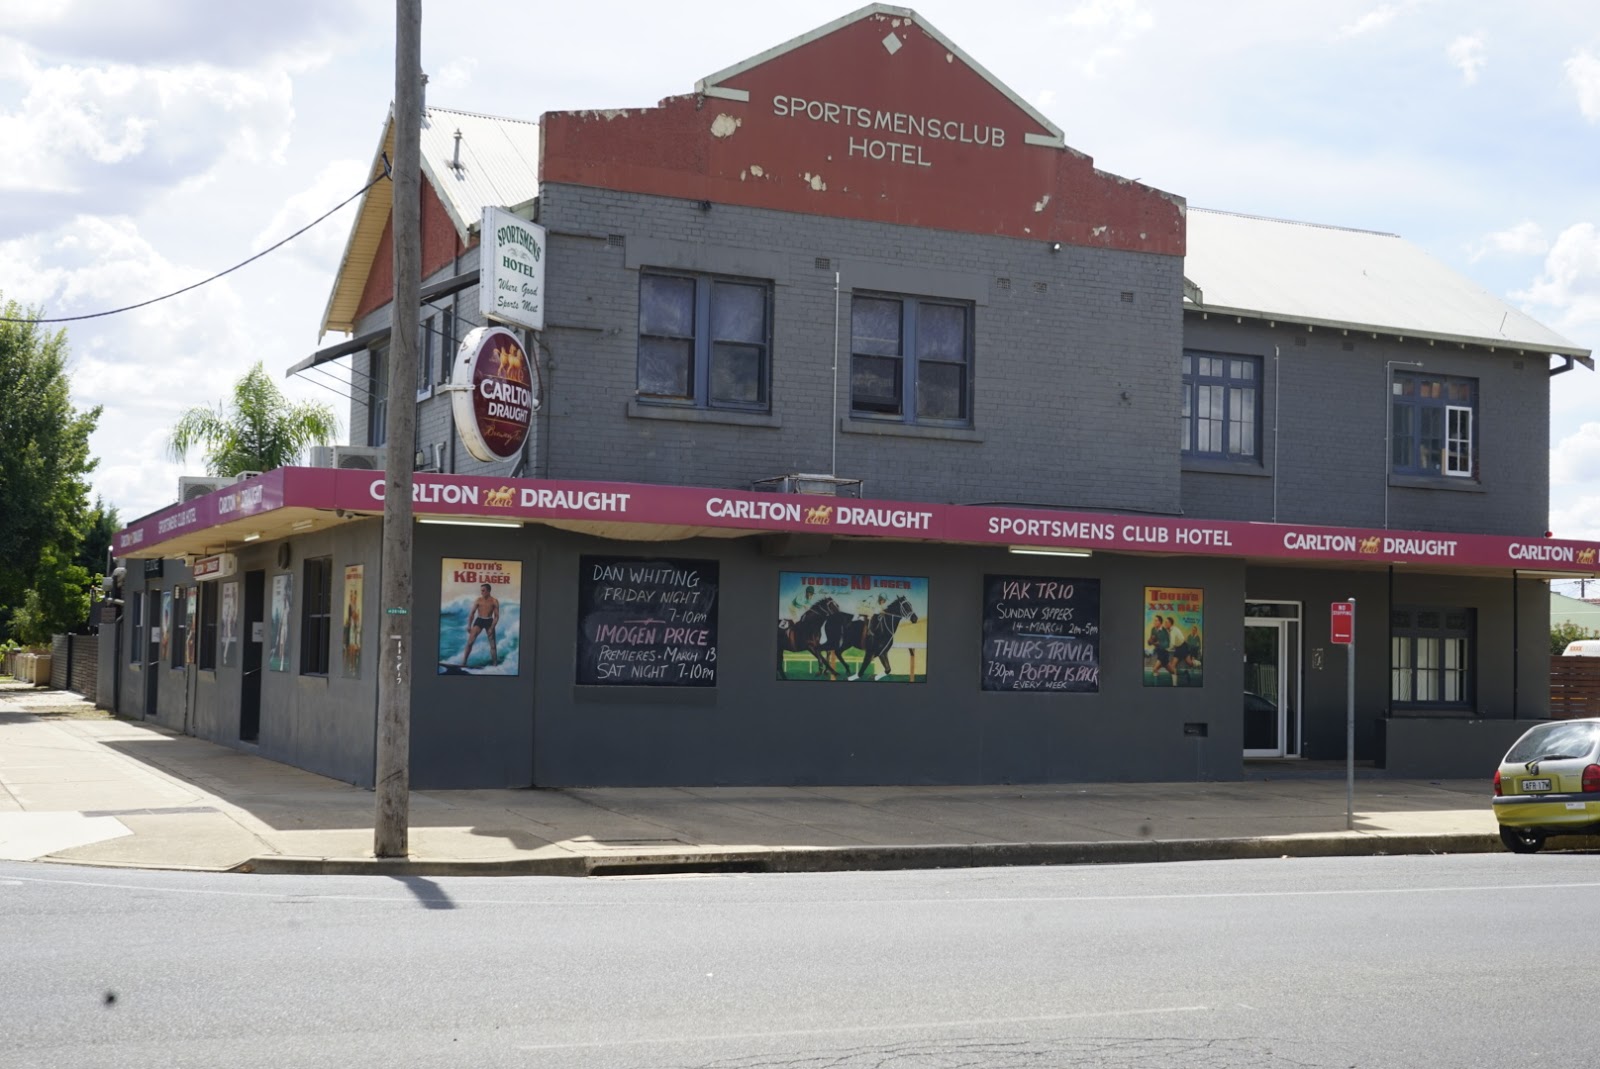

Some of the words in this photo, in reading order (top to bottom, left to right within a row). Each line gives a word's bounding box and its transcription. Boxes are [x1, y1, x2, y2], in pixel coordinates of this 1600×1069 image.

[849, 137, 931, 166] HOTEL
[497, 224, 541, 262] SPORTSMENS
[502, 255, 535, 278] HOTEL
[498, 278, 518, 293] Where
[521, 282, 538, 297] Good
[497, 296, 519, 311] Sports
[480, 378, 532, 408] CARLTON
[488, 401, 529, 424] DRAUGHT
[369, 479, 479, 505] CRLTON
[520, 488, 631, 512] DRAUGHT
[705, 497, 801, 522] CARLTON
[836, 506, 933, 530] DRAUGHT
[988, 516, 1115, 541] SPORTSMENS
[1122, 525, 1169, 543] CLUB
[1175, 528, 1233, 546] HOTEL
[1283, 531, 1356, 552] CARLTON
[1383, 537, 1457, 557] DRAUGHT
[1508, 542, 1574, 562] CARLTON
[463, 561, 503, 571] TOOTH'S
[593, 564, 624, 582] DAN
[630, 567, 700, 588] WHITING
[454, 570, 477, 583] KB
[479, 575, 511, 584] LAGER
[604, 587, 656, 602] FRIDAY
[660, 591, 700, 604] NIGHT
[1002, 581, 1031, 600] YAK
[1036, 582, 1074, 600] TRIO
[1148, 603, 1174, 611] XXX
[595, 624, 656, 646] IMOGEN
[663, 627, 709, 646] PRICE
[705, 647, 717, 662] 13
[994, 639, 1043, 660] THURS
[1047, 641, 1094, 662] TRIVIA
[597, 662, 625, 679] SAT
[631, 664, 669, 679] NIGHT
[1064, 667, 1075, 682] IS
[1013, 680, 1042, 689] EVERY
[1045, 681, 1067, 689] WEEK
